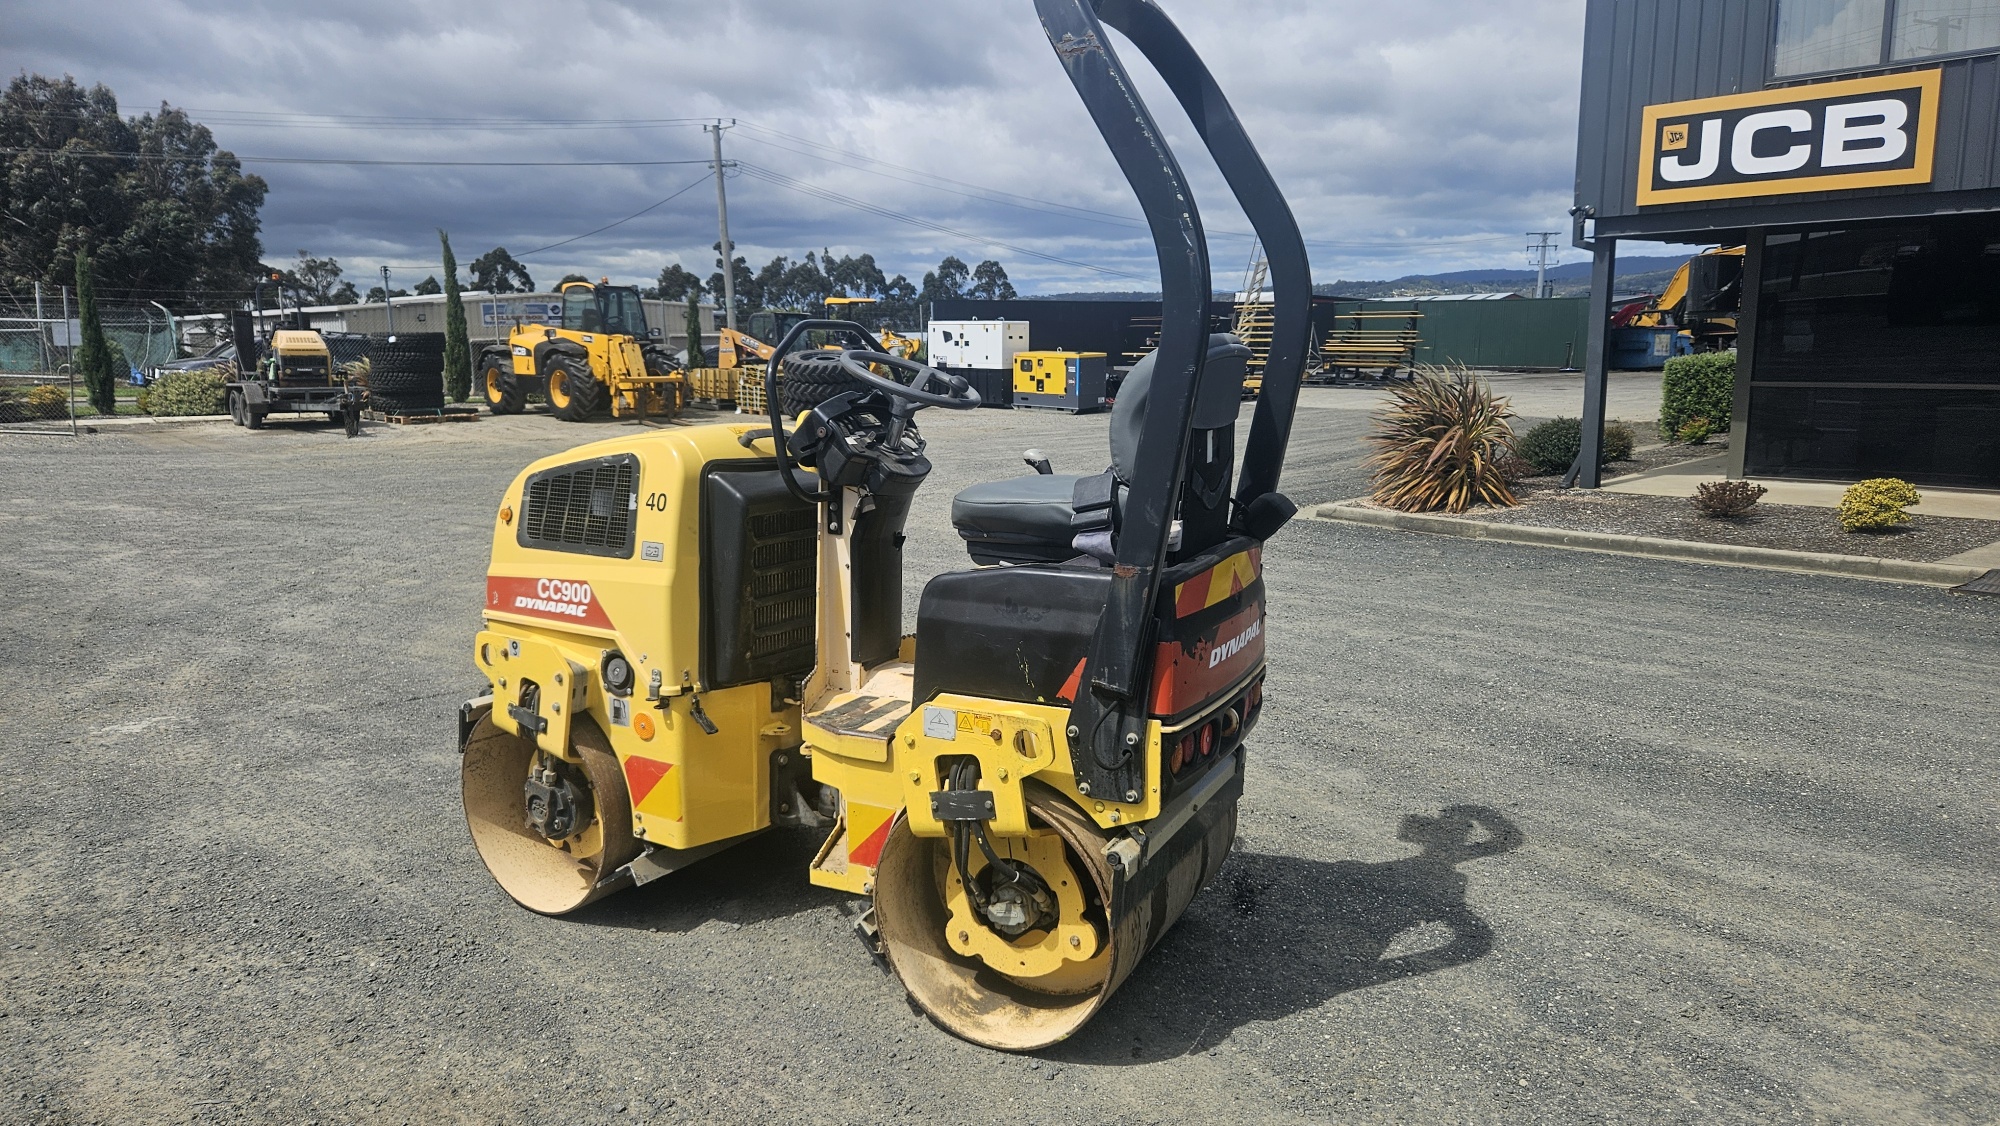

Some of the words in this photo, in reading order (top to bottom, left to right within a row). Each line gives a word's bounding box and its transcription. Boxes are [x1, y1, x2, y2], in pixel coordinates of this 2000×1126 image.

[1659, 98, 1908, 182] JCB
[1669, 132, 1685, 143] JCB
[512, 346, 527, 356] JCB
[741, 336, 759, 349] CASE
[645, 492, 667, 512] 40
[537, 578, 592, 604] CC900
[514, 596, 588, 617] DYNAPAC
